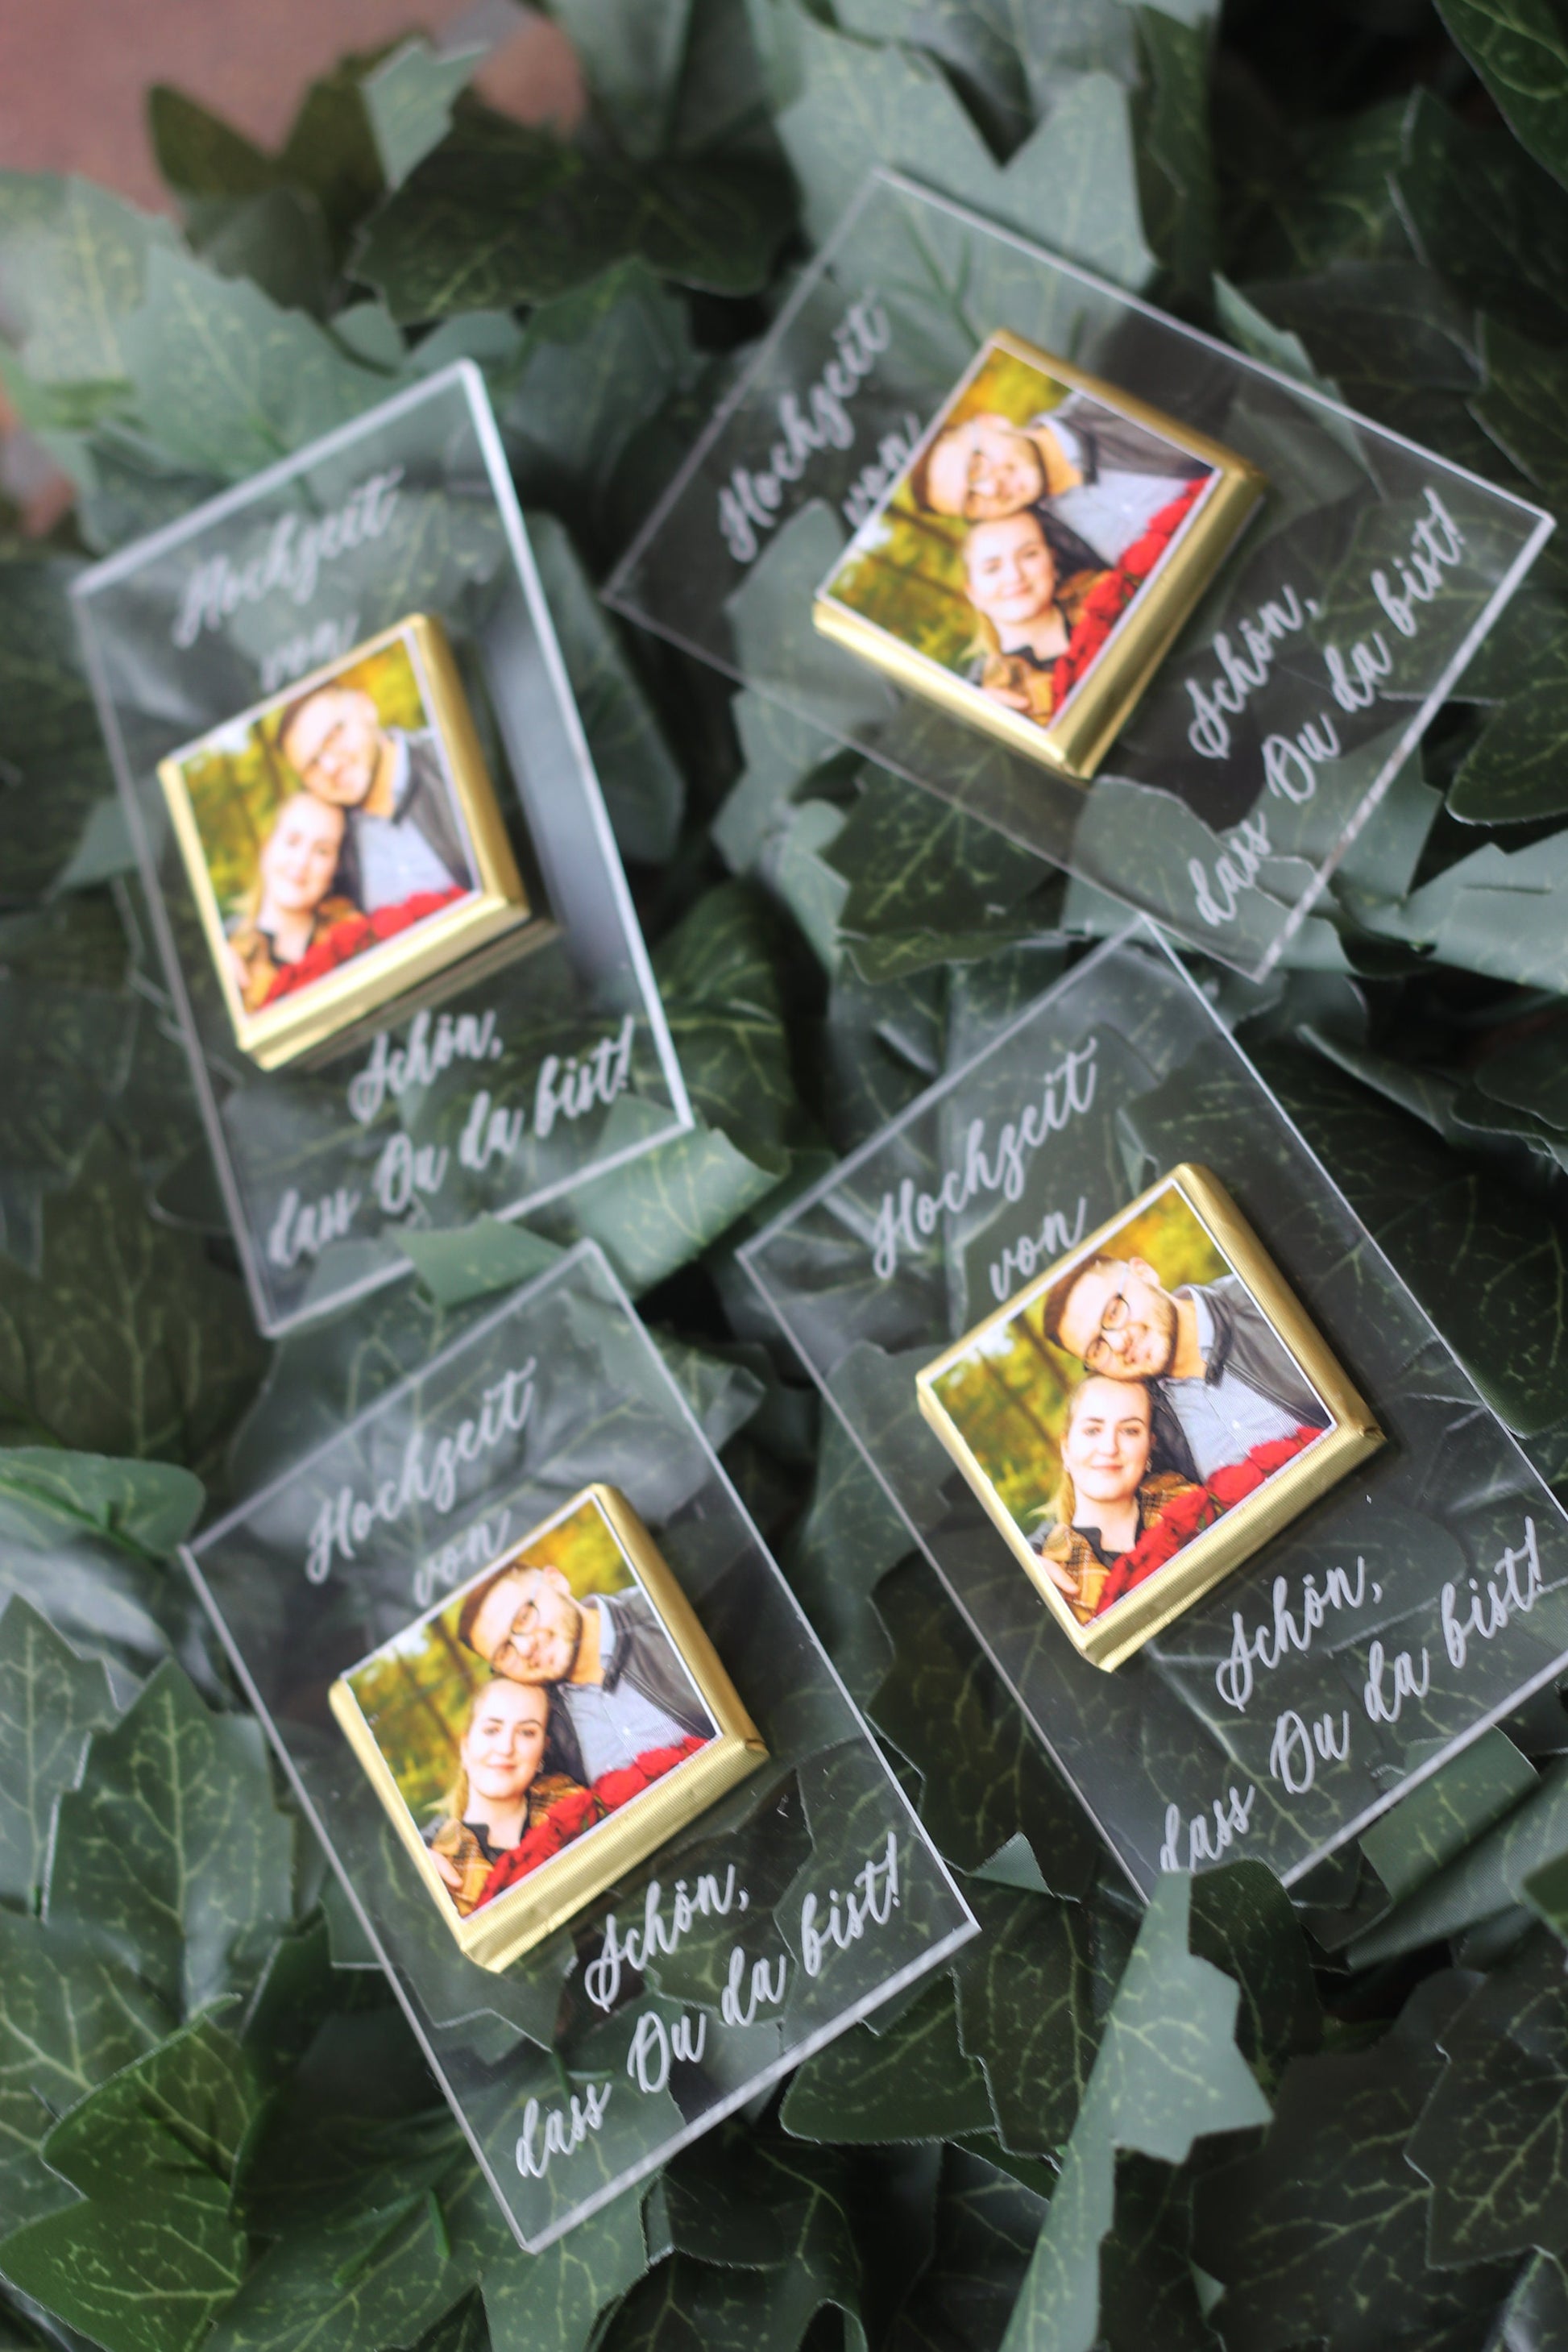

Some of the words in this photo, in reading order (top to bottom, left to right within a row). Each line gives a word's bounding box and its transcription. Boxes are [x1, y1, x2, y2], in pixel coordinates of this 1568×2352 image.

[718, 284, 891, 562] Hochzeit
[1184, 583, 1317, 760] Schön,
[1261, 713, 1341, 803] Du
[1323, 631, 1392, 713] da
[1371, 485, 1466, 637] bist!
[533, 1014, 635, 1139] bist!
[873, 1036, 1097, 1280] Hochzeit
[990, 1197, 1085, 1301] von
[305, 1356, 537, 1584] Hochzeit
[413, 1508, 512, 1607] von
[1160, 1786, 1255, 1871] dass
[1270, 1710, 1350, 1794] Du
[1364, 1641, 1429, 1722] da
[1441, 1516, 1546, 1668] bist!
[1216, 1556, 1383, 1711] Schön,
[516, 2083, 612, 2177] dass
[627, 2011, 706, 2093] Du
[722, 1947, 786, 2027] da
[802, 1831, 898, 1977] bist!
[585, 1864, 749, 2012] Schön,
